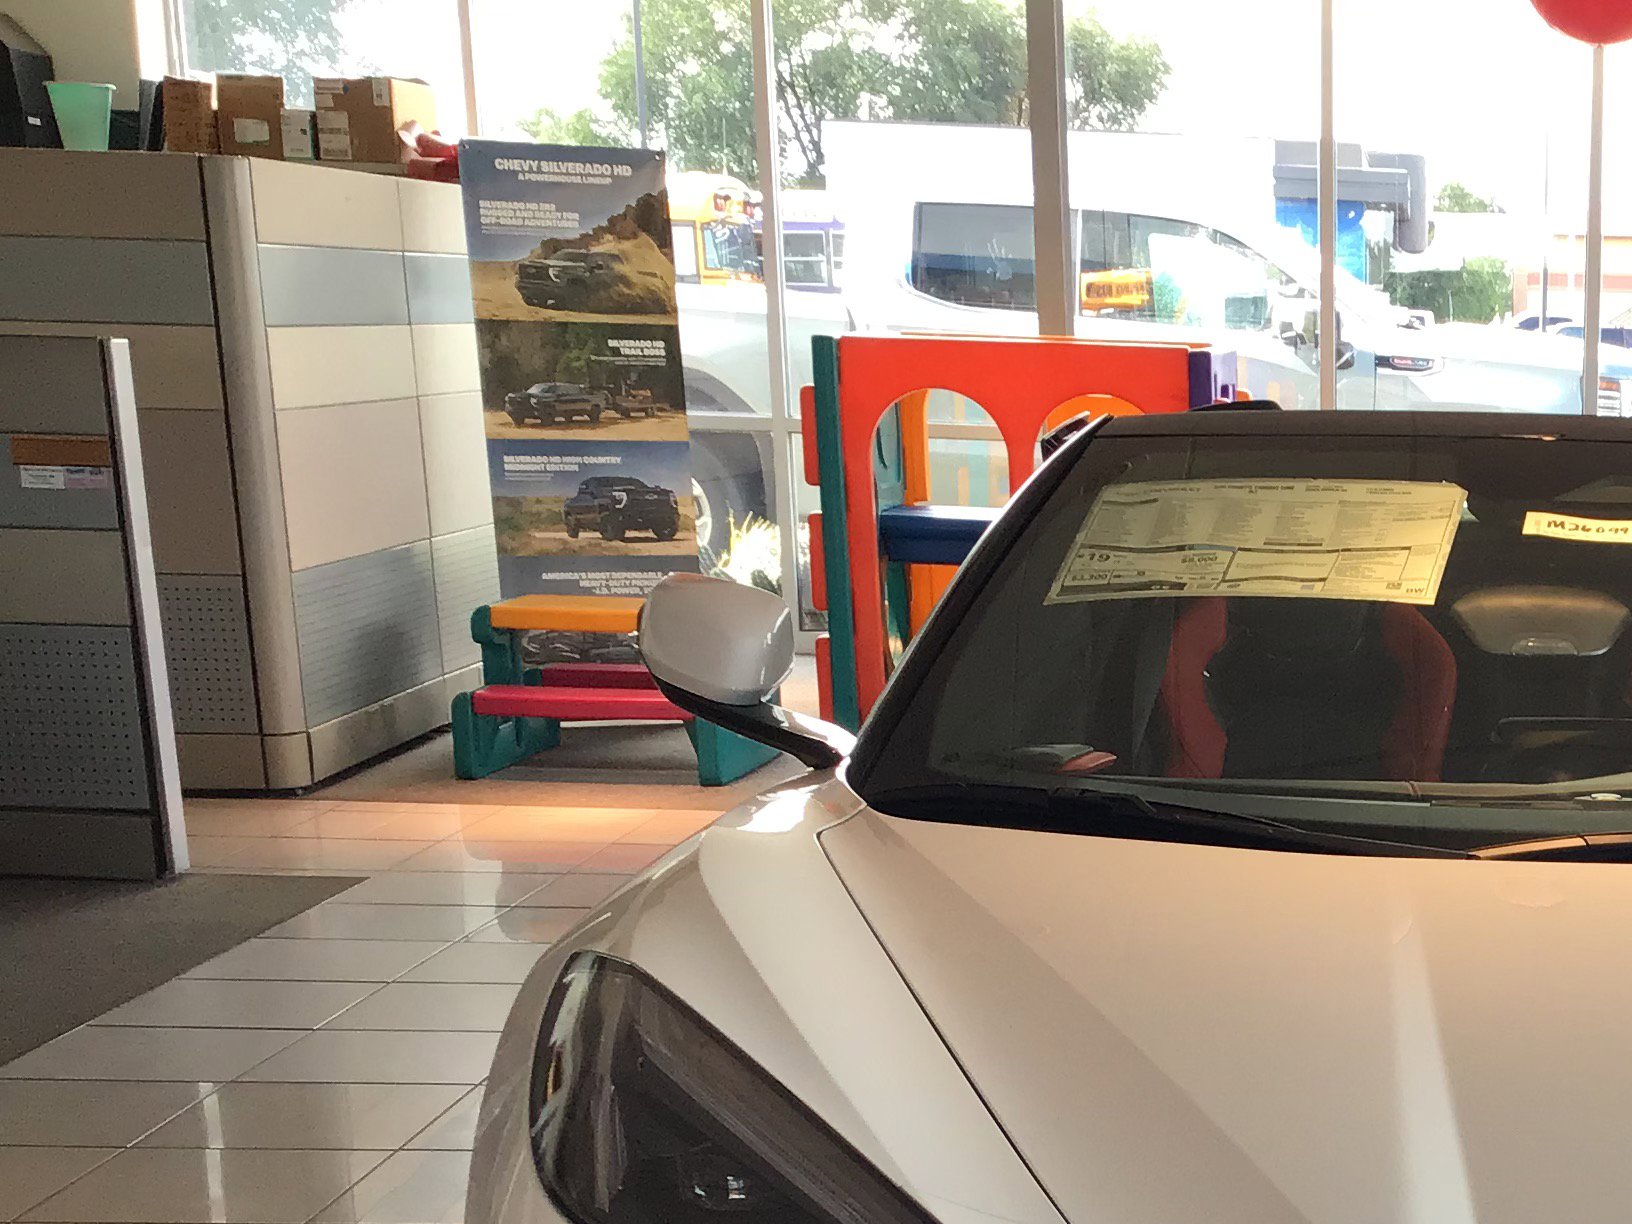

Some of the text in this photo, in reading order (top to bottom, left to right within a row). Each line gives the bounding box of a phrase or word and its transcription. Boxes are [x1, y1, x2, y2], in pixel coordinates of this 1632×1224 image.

[494, 157, 633, 177] CHEVY SILVERADO HD
[526, 173, 583, 184] POWERHOUSE
[479, 200, 525, 210] SILVERADO
[515, 210, 534, 218] AND
[563, 212, 580, 221] FOR
[607, 339, 652, 348] SILVERADO
[620, 348, 666, 357] TRAIL BOSS
[503, 455, 548, 464] SILVERADO
[582, 456, 621, 465] COUNTRY
